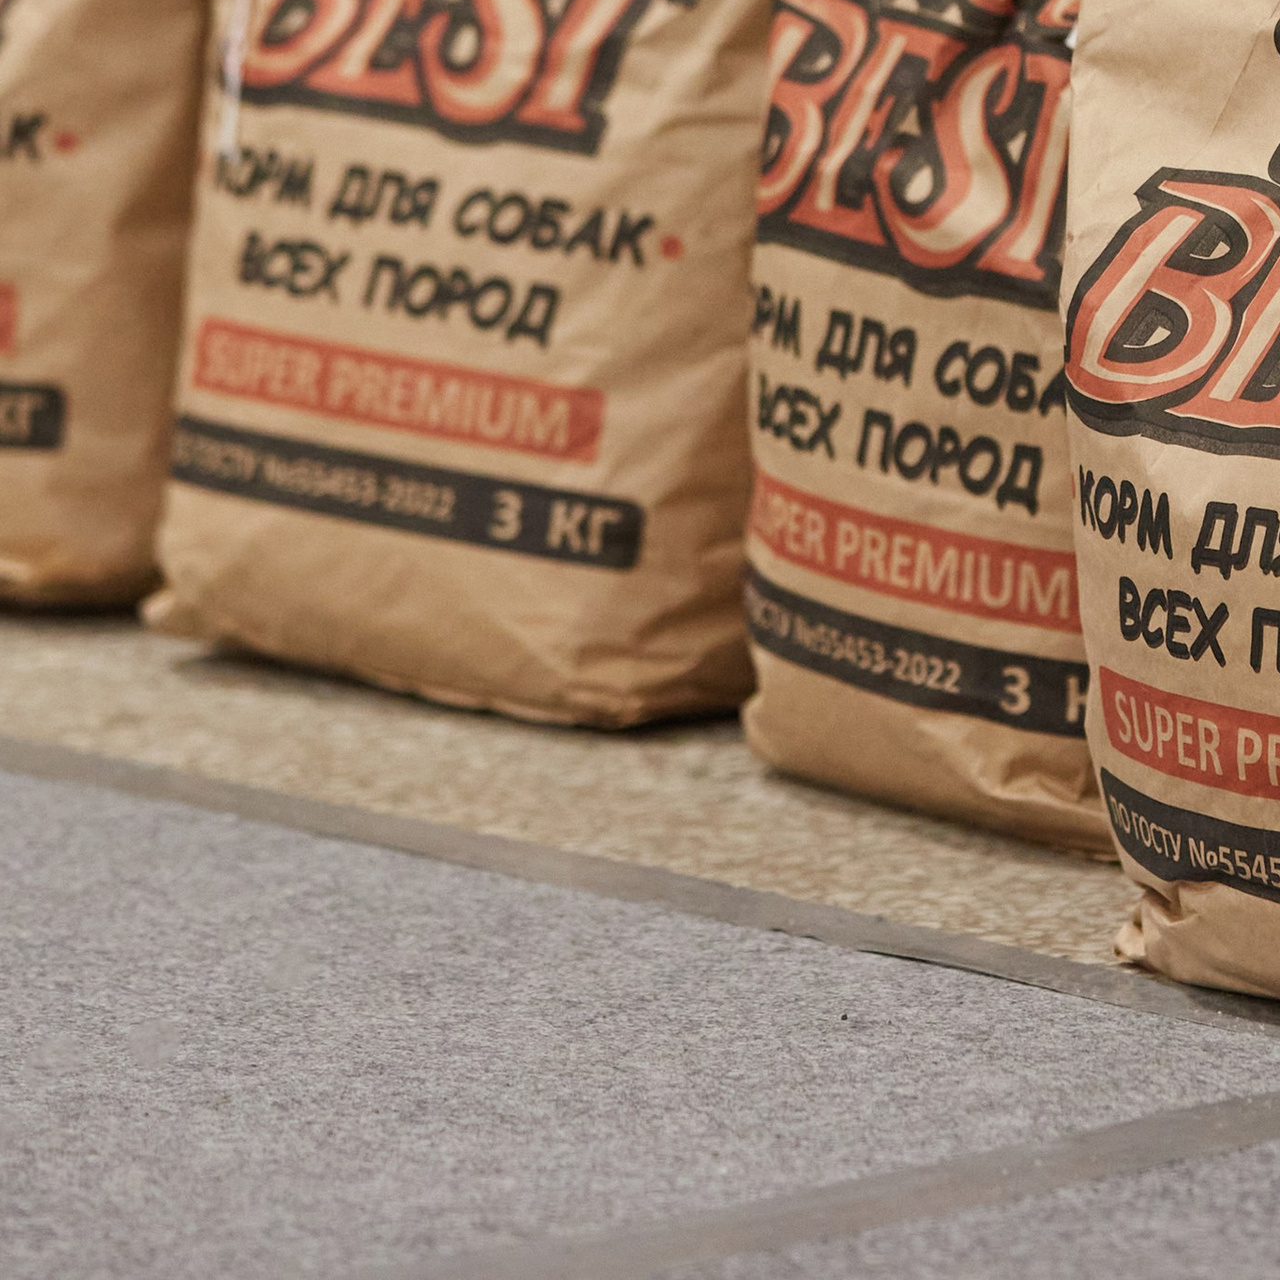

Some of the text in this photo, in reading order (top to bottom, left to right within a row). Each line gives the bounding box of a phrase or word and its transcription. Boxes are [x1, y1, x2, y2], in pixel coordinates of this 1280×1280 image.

[327, 162, 439, 230] ДЛЯ
[452, 187, 655, 267] СОБАК
[237, 229, 561, 347] ВСЕХ ПОРОД
[207, 332, 572, 450] SUPER PREMIUM
[816, 308, 917, 388] ДЛЯ
[857, 408, 1044, 517] ПОРОД
[488, 488, 522, 542] 3
[546, 499, 622, 554] КГ
[1079, 464, 1174, 561] КОРМ
[835, 519, 1072, 620] PREMIUM
[1118, 576, 1230, 667] ВСЕХ
[1001, 666, 1032, 716] 3
[1113, 688, 1225, 778] SUPER
